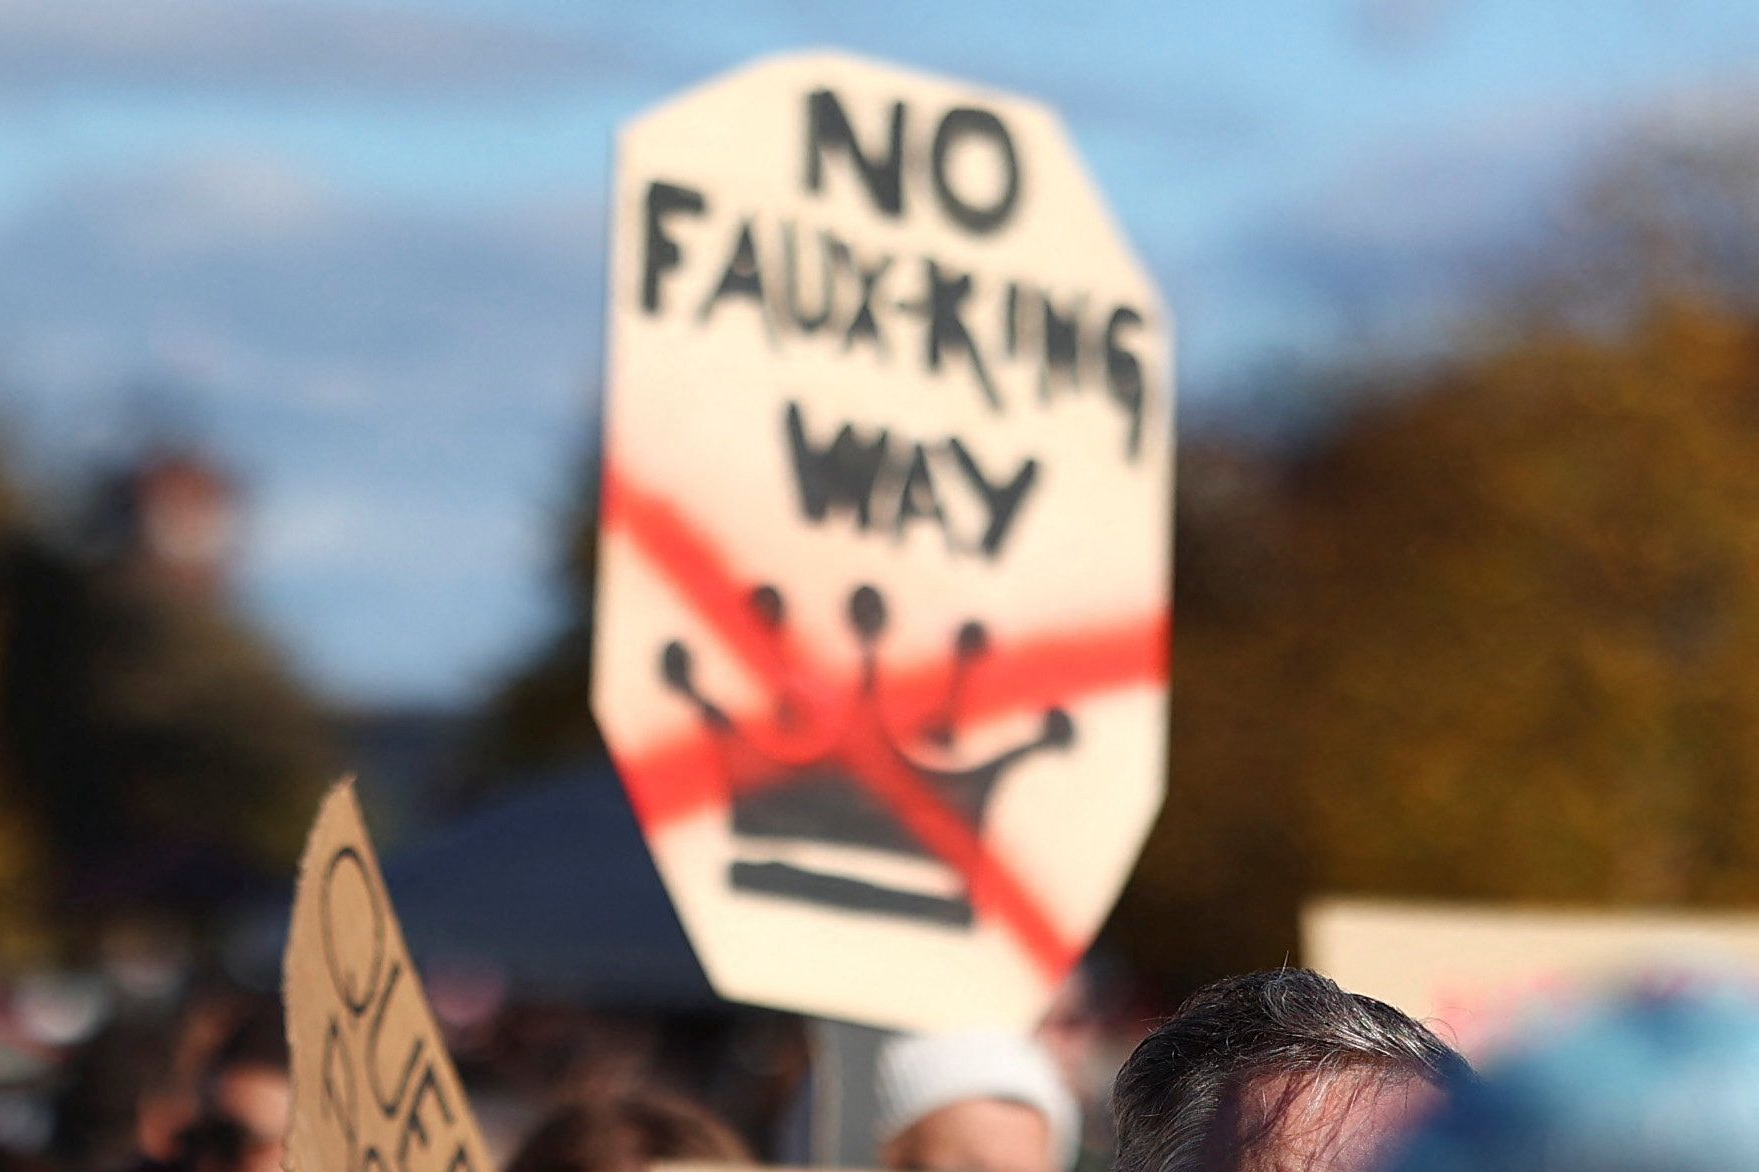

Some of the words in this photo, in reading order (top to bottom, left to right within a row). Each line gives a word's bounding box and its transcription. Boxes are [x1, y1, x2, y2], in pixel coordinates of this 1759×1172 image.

[803, 86, 1023, 235] NO
[642, 180, 1146, 464] FAUX-KING
[784, 400, 1040, 560] WAY
